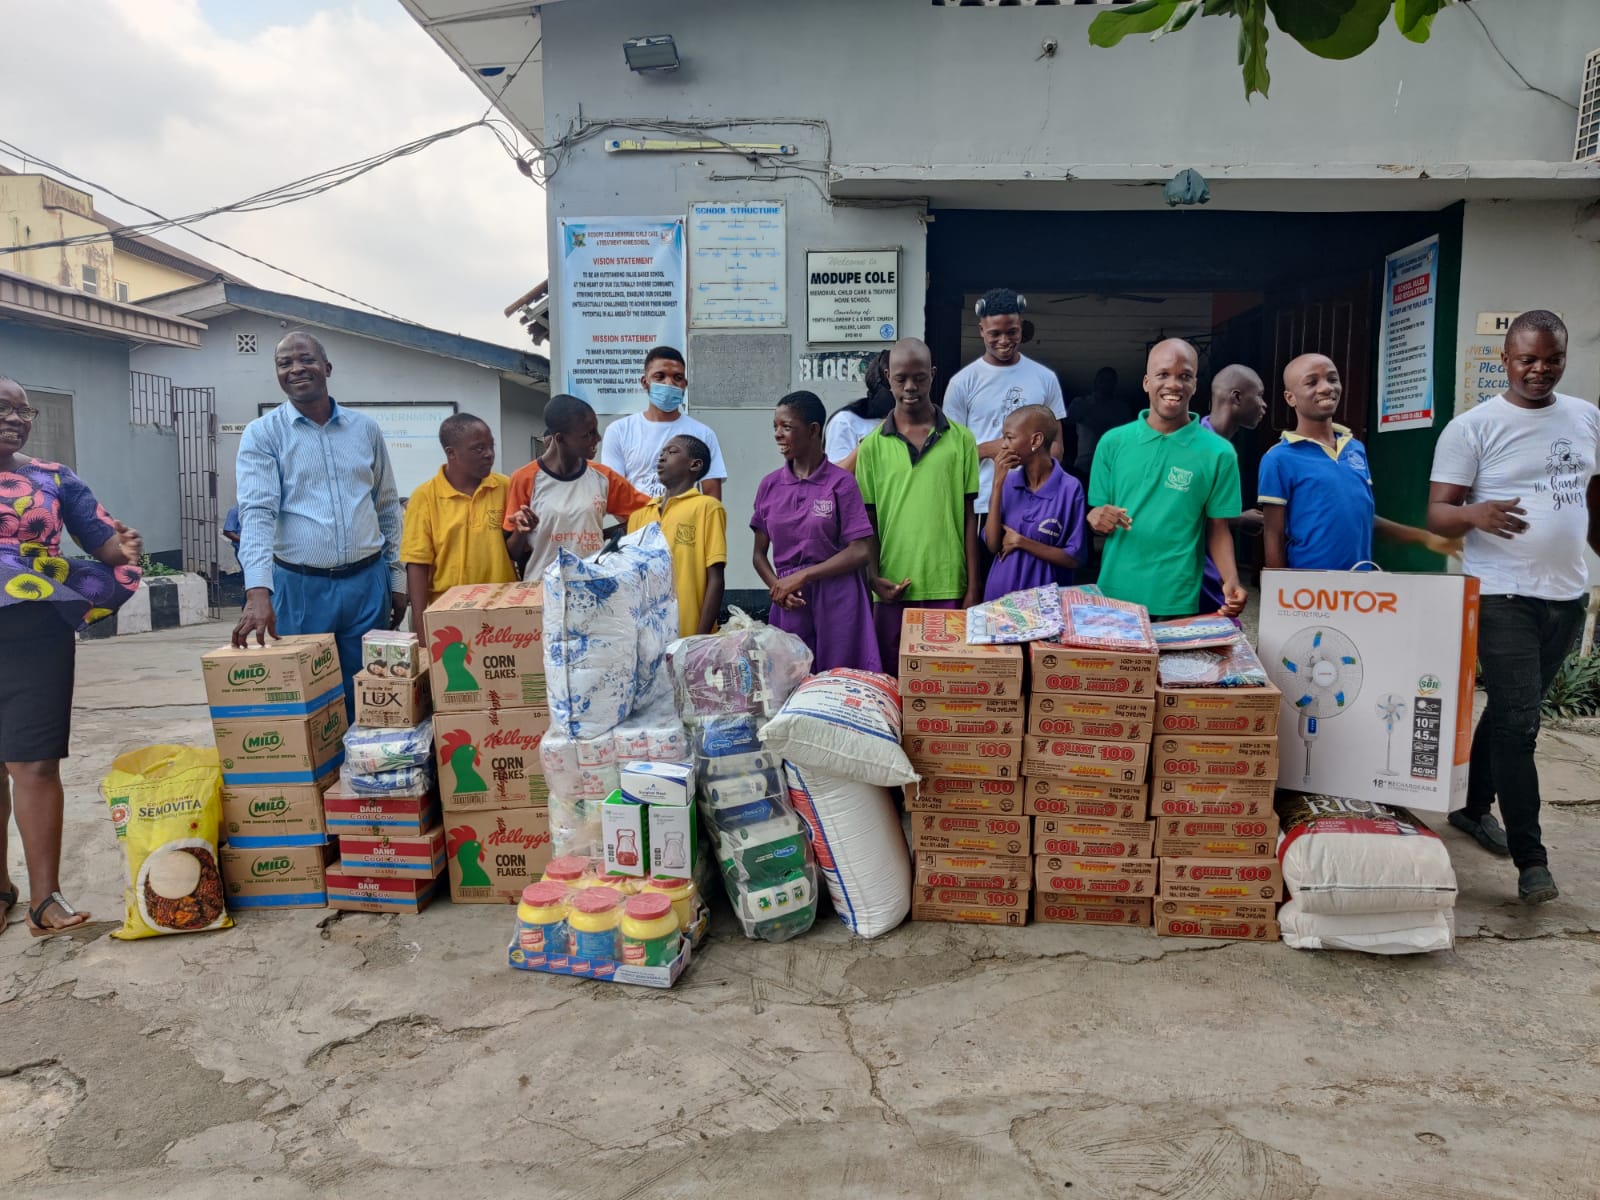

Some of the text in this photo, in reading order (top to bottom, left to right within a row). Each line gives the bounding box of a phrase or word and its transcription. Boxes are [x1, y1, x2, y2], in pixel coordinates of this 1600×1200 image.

[592, 257, 654, 265] VISION STATEMENT
[810, 271, 895, 285] MODUPE COLE
[799, 358, 864, 382] BLOCK
[1278, 587, 1398, 613] LONTOR
[475, 625, 542, 648] Kellogg's
[313, 650, 332, 671] MILO
[483, 655, 516, 669] CORN
[233, 667, 266, 681] MILO
[909, 679, 944, 694] 100
[1046, 674, 1082, 690] 100
[362, 691, 403, 707] LUX
[917, 718, 952, 733] 100
[1039, 718, 1075, 734] 100
[1163, 714, 1200, 730] 100
[1415, 718, 1429, 728] 10
[248, 734, 280, 748] MILO
[484, 729, 546, 750] Kellogg'
[976, 742, 1011, 758] 100
[1098, 745, 1136, 763] 100
[492, 757, 524, 770] CORN
[1164, 759, 1200, 774] 100
[980, 779, 1015, 795] 100
[138, 799, 202, 818] SEMOVITA
[254, 800, 286, 813] MILO
[360, 805, 382, 813] DANO
[1034, 797, 1069, 813] 100
[1162, 799, 1198, 814] 100
[1305, 798, 1396, 816] RICE
[986, 818, 1021, 834] 100
[1232, 822, 1267, 836] 100
[488, 827, 550, 849] Kellogg's
[1045, 839, 1080, 854] 100
[257, 860, 290, 872] MILO
[496, 854, 526, 867] CORN
[1236, 866, 1271, 881] 100
[358, 882, 379, 890] DANO
[1050, 876, 1085, 891] 100
[984, 891, 1019, 906] 100
[1044, 905, 1079, 920] 100
[1168, 920, 1203, 934] 100
